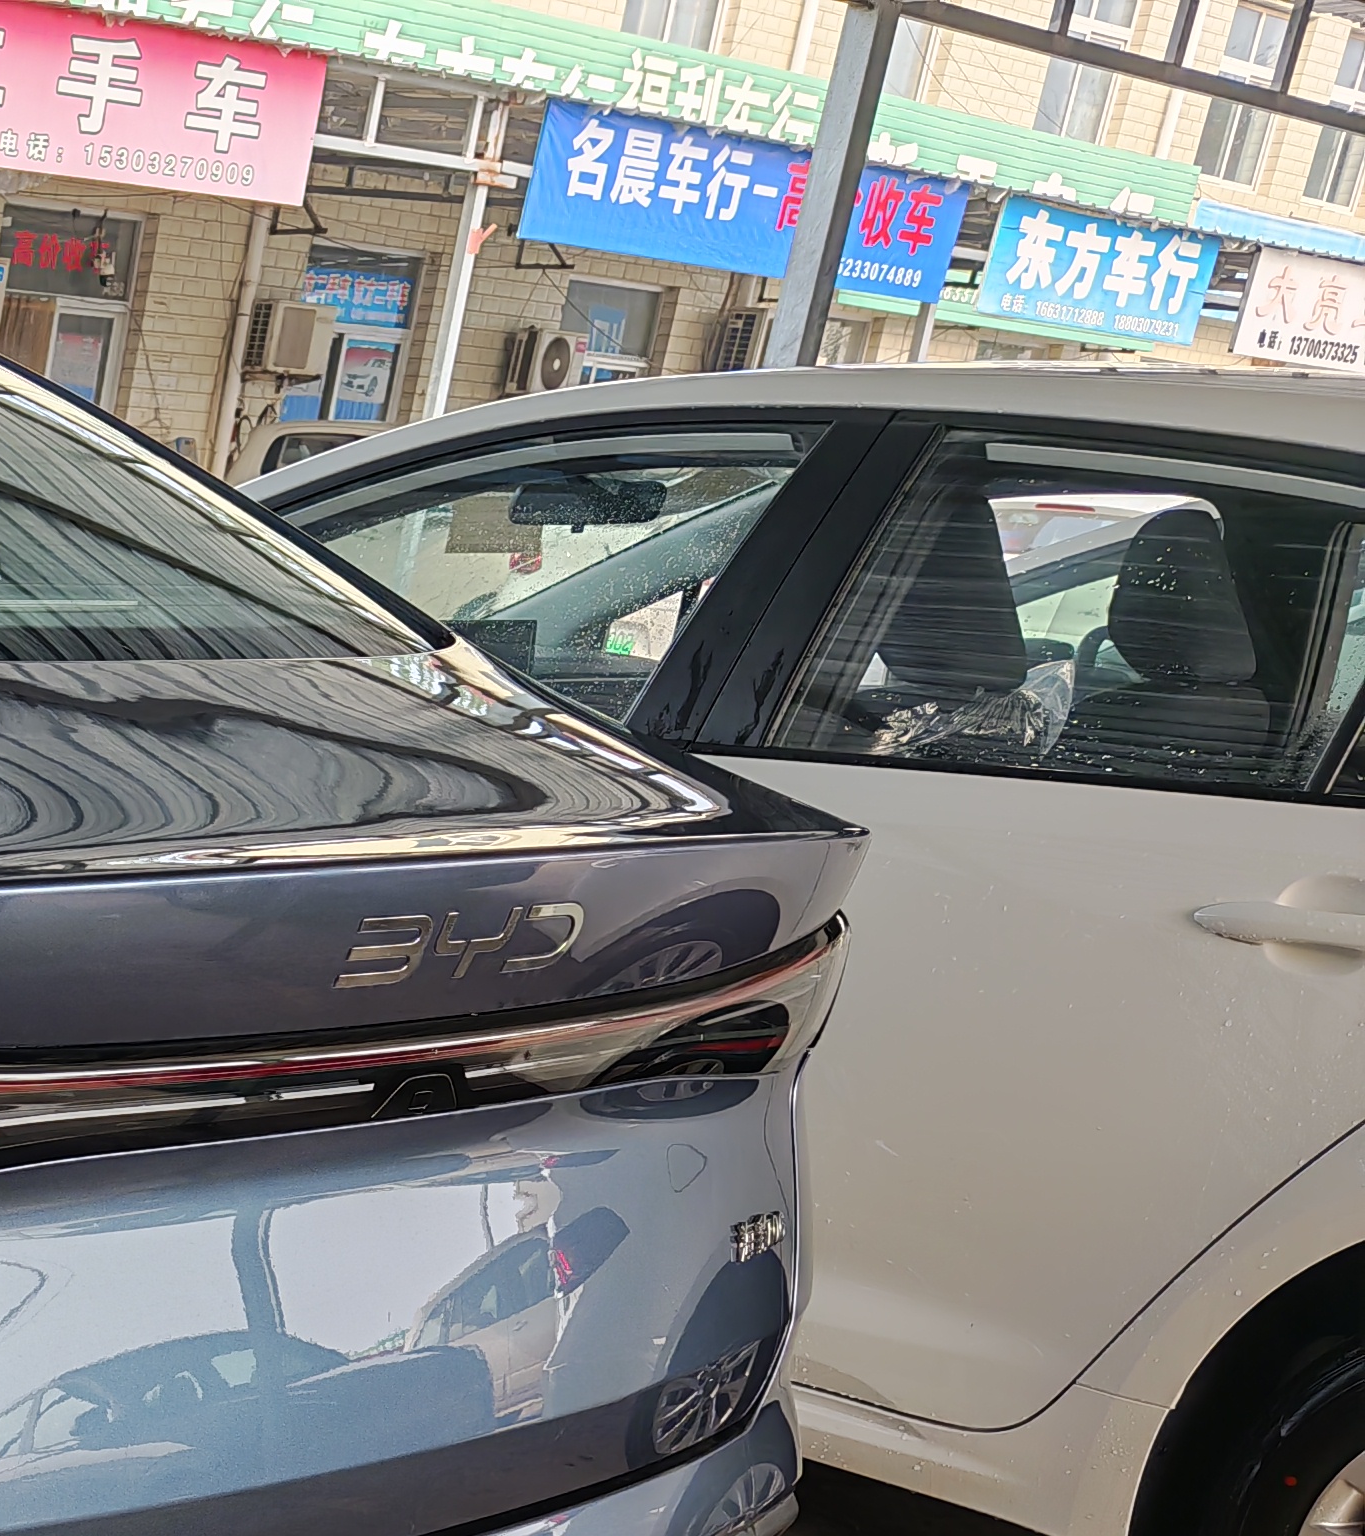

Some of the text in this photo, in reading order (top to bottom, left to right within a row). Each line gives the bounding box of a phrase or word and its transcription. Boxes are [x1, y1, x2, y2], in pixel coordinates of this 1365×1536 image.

[83, 142, 256, 187] 15303270909
[1006, 208, 1202, 316] 东方车行
[1288, 335, 1361, 365] 13700373325
[331, 901, 585, 989] BYD
